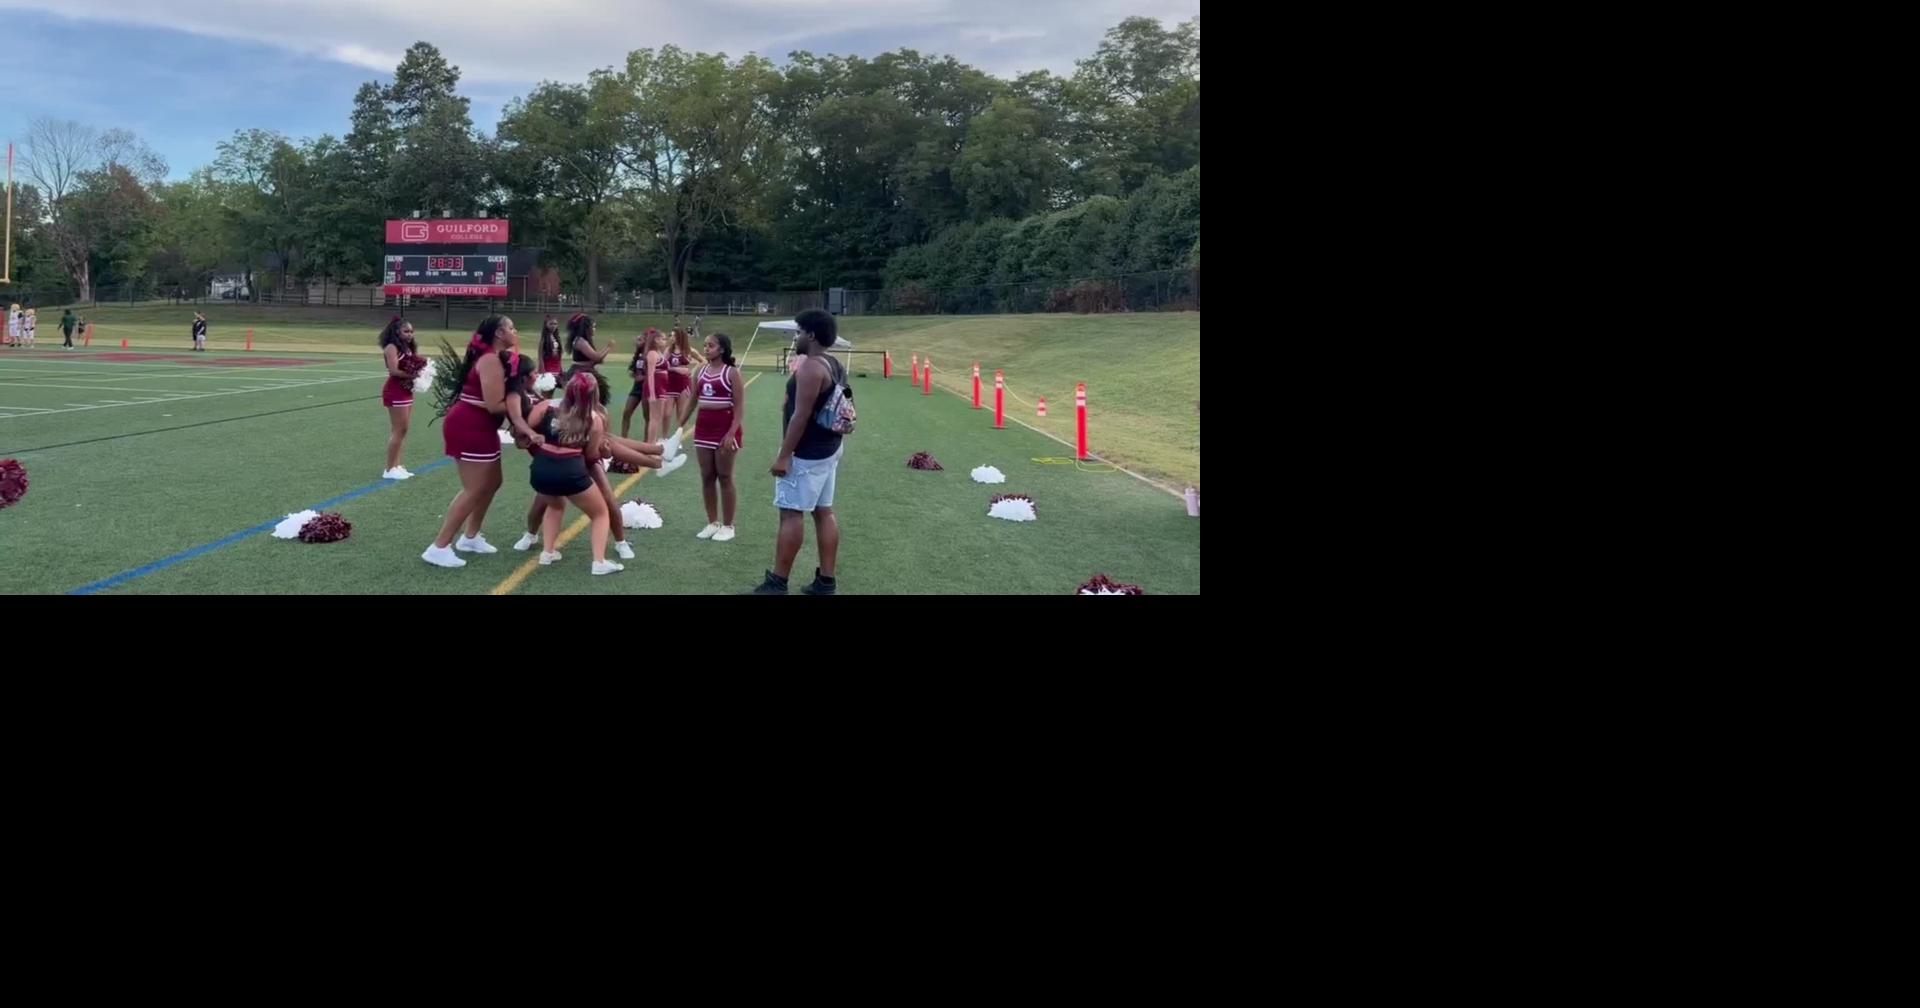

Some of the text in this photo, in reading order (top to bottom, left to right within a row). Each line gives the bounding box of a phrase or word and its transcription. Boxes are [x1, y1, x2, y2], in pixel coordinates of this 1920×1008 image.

[436, 224, 498, 233] GUILFORD
[429, 258, 462, 268] 28:33
[402, 286, 488, 294] HERB APPENZELLER FIELD
